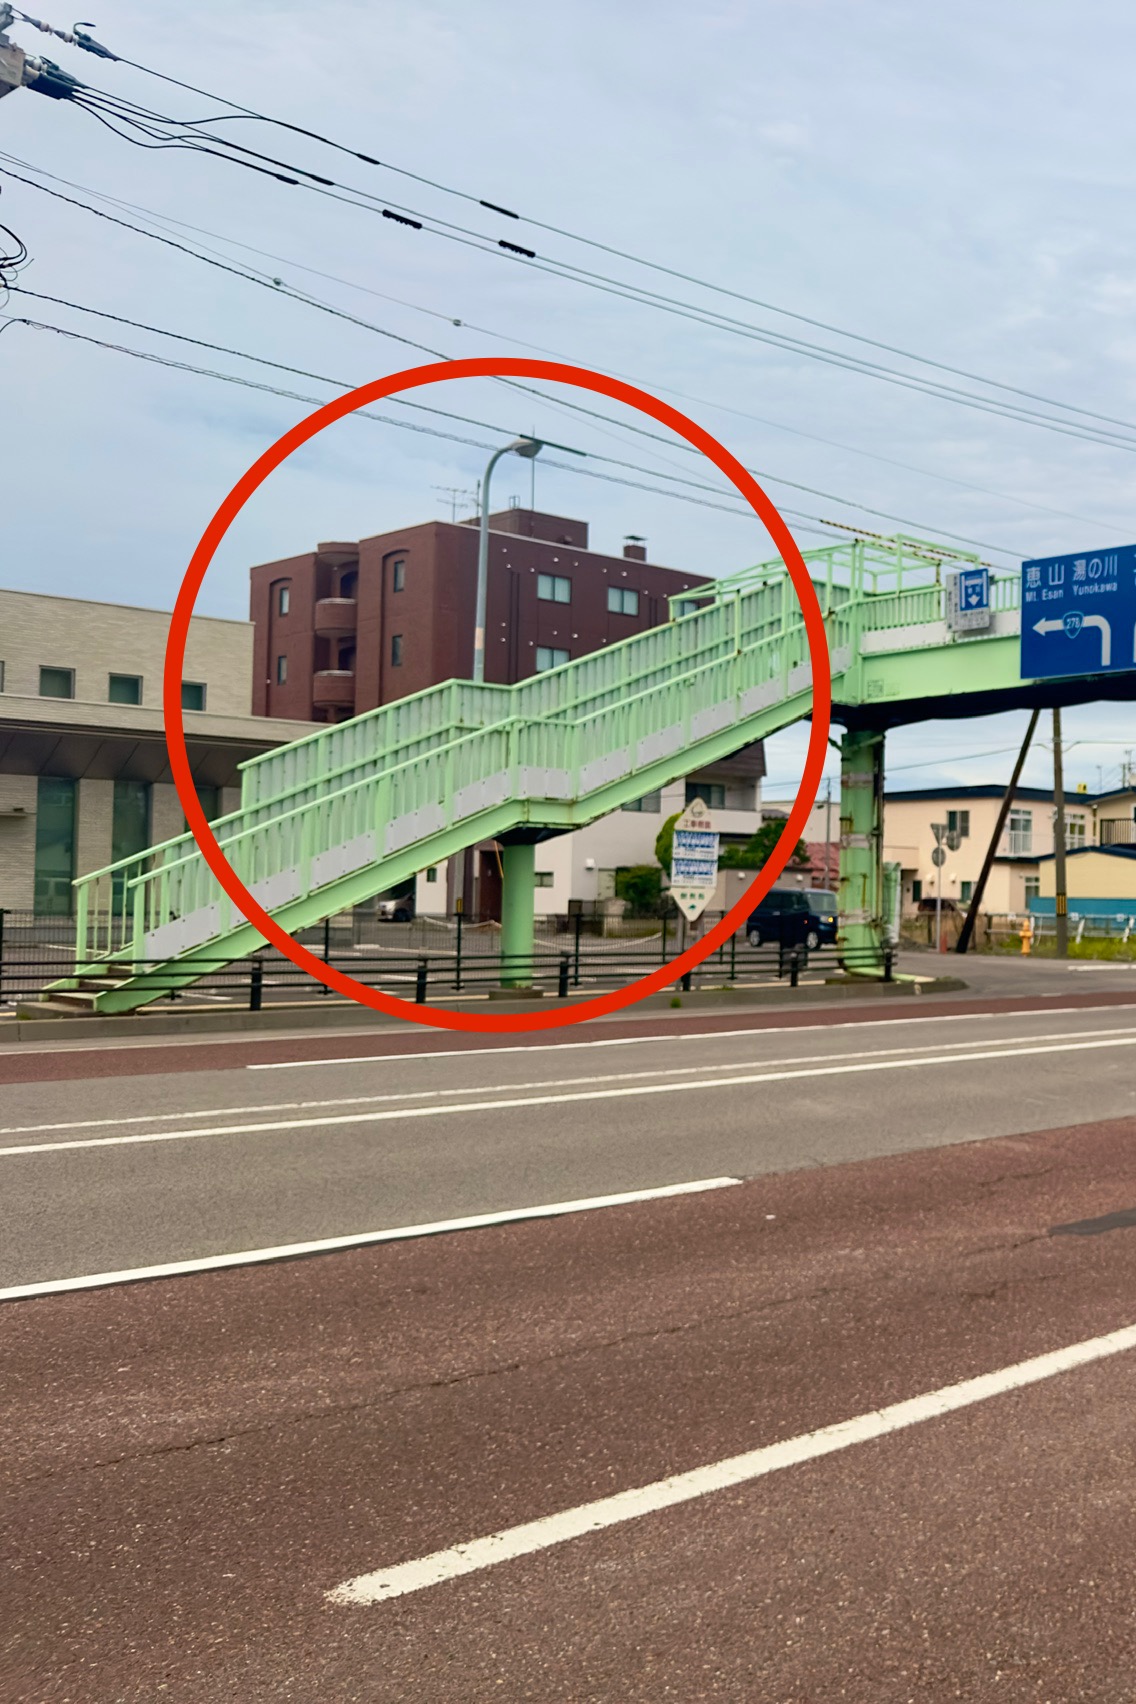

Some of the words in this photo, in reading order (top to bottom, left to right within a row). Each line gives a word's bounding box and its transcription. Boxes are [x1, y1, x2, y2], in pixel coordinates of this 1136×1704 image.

[1026, 563, 1064, 588] 恵山
[1072, 555, 1118, 581] 湯の川
[1042, 589, 1064, 601] Esan
[1073, 581, 1118, 596] Yunokawa
